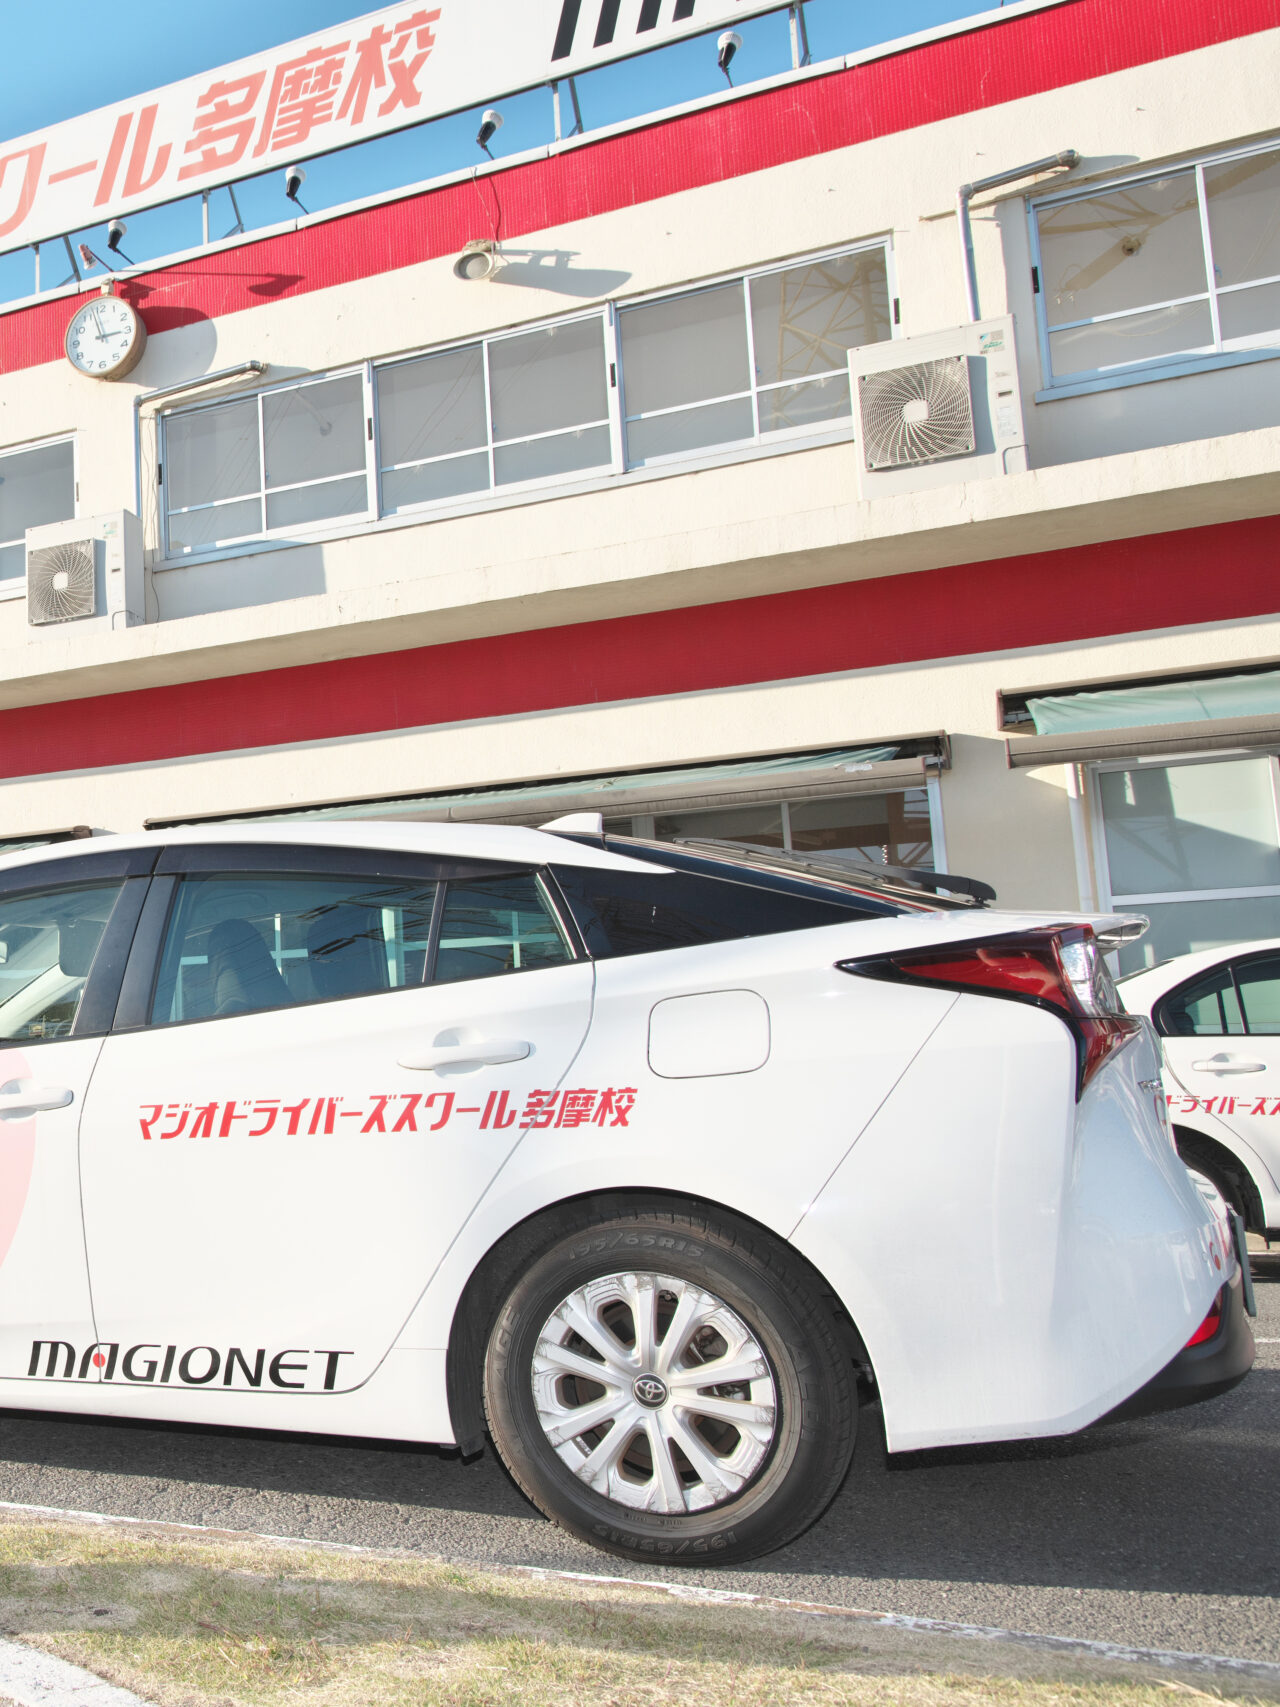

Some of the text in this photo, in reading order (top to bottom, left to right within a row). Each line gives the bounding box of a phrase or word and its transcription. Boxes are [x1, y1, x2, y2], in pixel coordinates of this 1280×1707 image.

[120, 312, 128, 321] 2
[75, 326, 86, 335] 10
[124, 326, 132, 334] 3
[72, 340, 80, 348] 9
[120, 340, 128, 348] 4
[76, 352, 84, 360] 8
[112, 353, 120, 361] 5
[87, 360, 94, 369] 7
[98, 361, 107, 369] 6
[138, 1086, 639, 1140] マジオドライバーズスクール多摩校
[27, 1340, 354, 1391] MAGIONET
